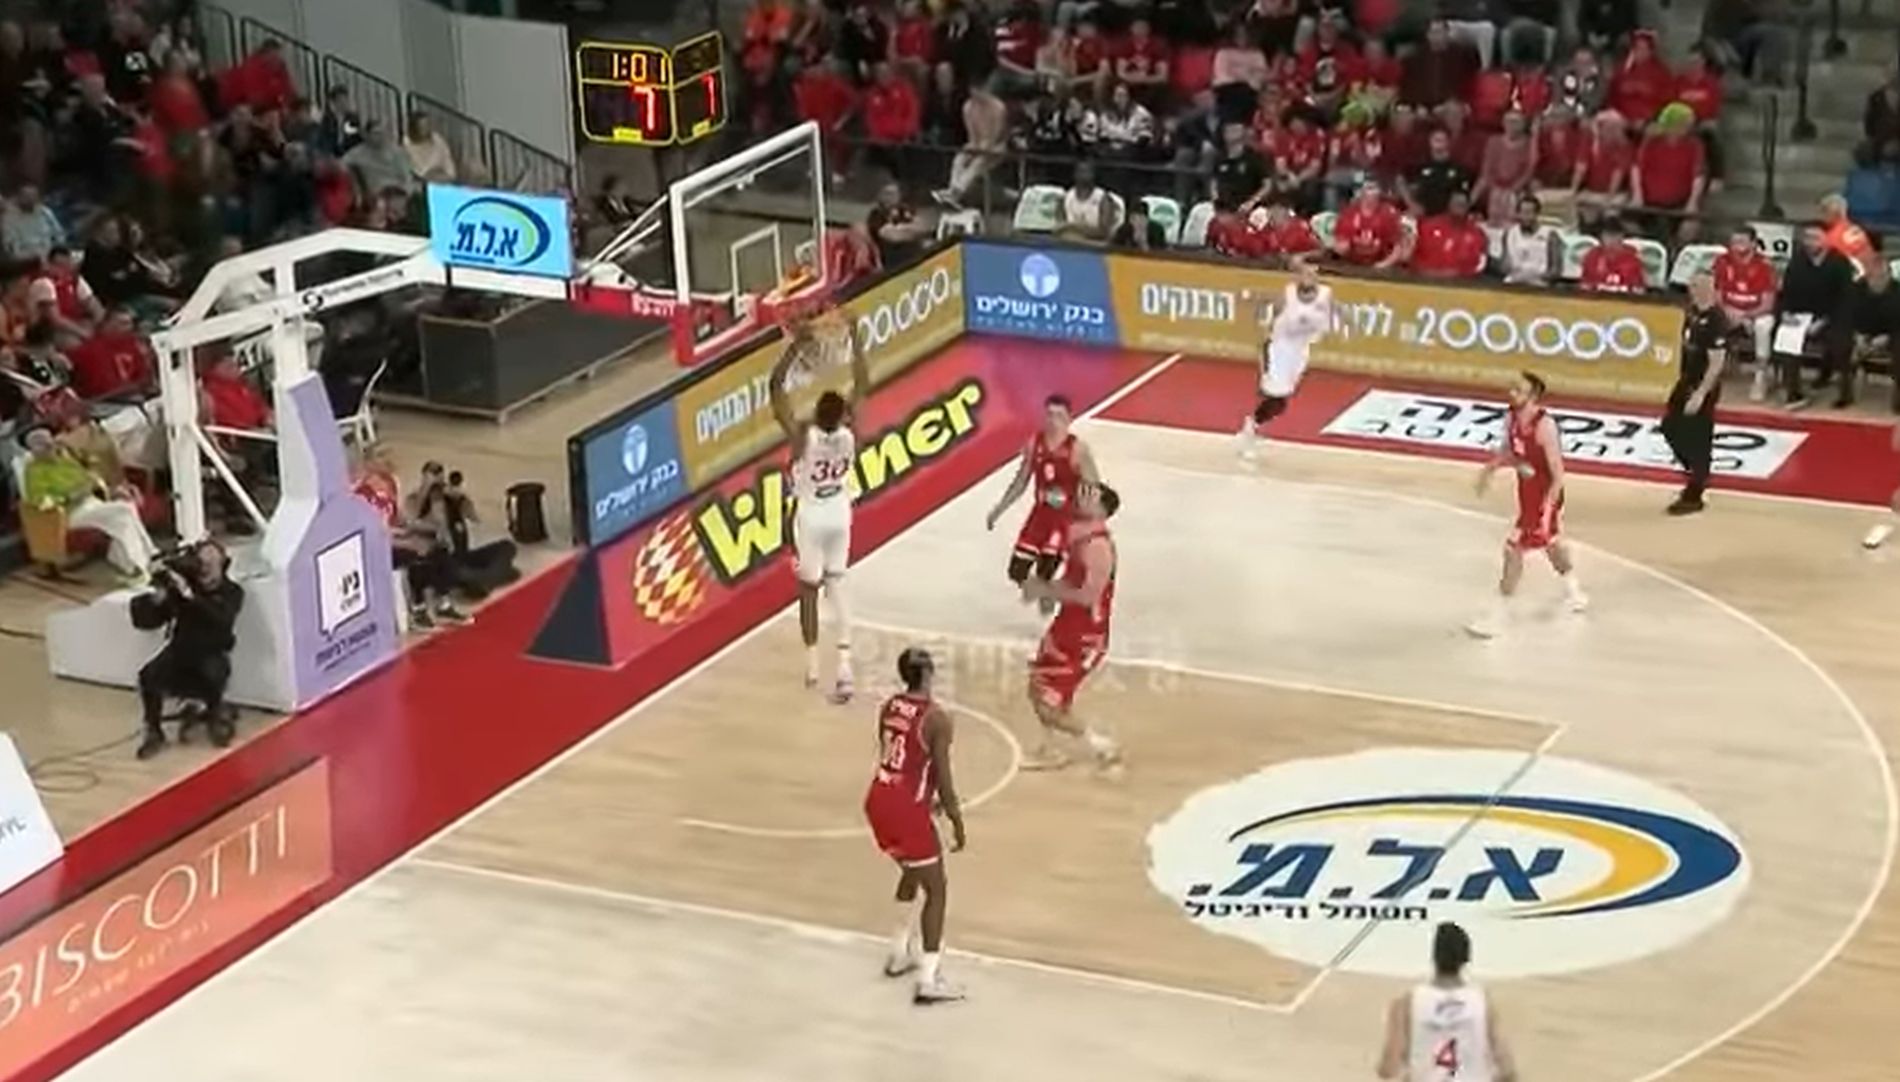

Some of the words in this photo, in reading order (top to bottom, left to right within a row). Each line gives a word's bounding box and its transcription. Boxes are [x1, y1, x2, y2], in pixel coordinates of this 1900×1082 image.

[612, 52, 667, 83] 1:01
[633, 86, 656, 131] 7
[975, 295, 1059, 320] ירושלים
[1063, 301, 1104, 325] בנק
[1141, 282, 1235, 323] הבנקים
[1187, 837, 1566, 902] א.ל.מ.
[1183, 899, 1310, 920] ודיגיטל
[1318, 900, 1429, 920] חשמל
[1435, 1038, 1458, 1078] 4
